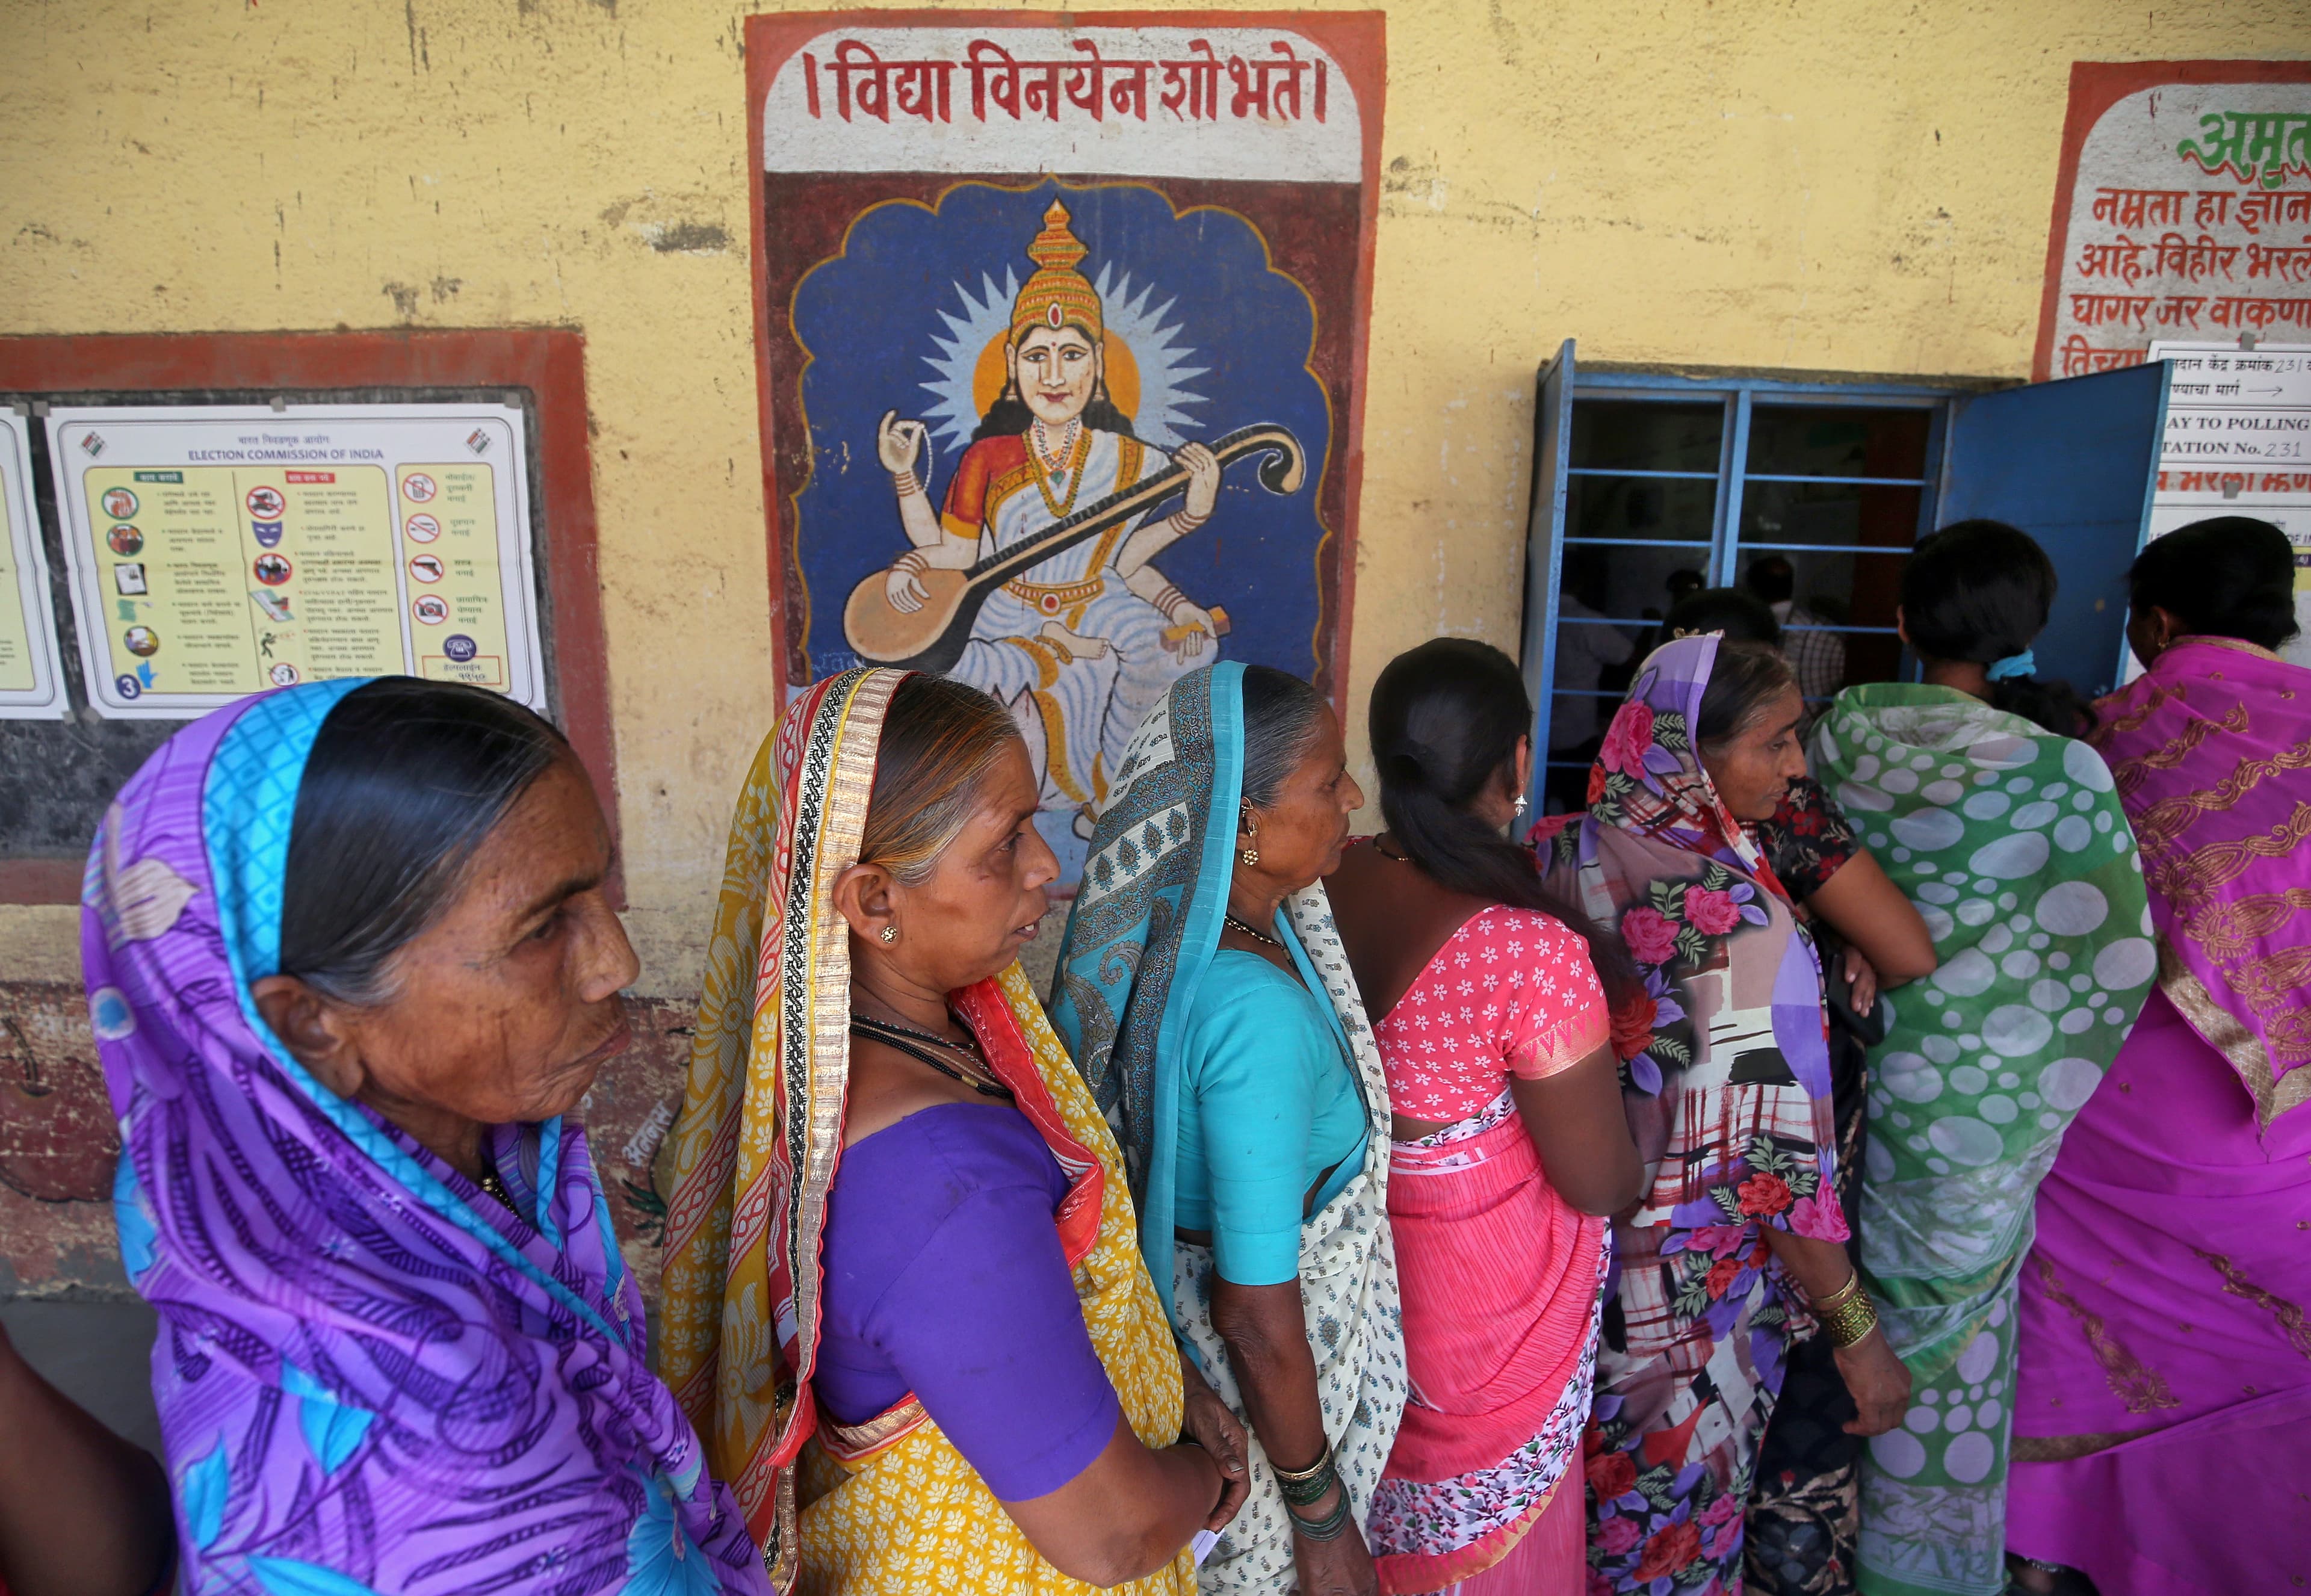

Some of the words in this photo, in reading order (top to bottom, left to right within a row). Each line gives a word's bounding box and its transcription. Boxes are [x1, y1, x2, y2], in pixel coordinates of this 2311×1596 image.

[961, 39, 1156, 122] विनयेन
[2093, 188, 2189, 229] नम्रता
[2194, 191, 2236, 230] हा
[2070, 294, 2155, 332] घागर
[2156, 297, 2208, 330] जर
[2167, 417, 2191, 429] AY
[2197, 418, 2221, 430] TO
[2227, 418, 2310, 431] POLLING
[188, 450, 244, 461] ELECTION
[247, 449, 327, 460] COMMISSION
[331, 449, 346, 459] OF
[349, 449, 384, 459] INDIA
[2162, 441, 2229, 453] TATION
[2234, 442, 2261, 455] No.
[2263, 442, 2301, 457] 231
[121, 677, 137, 696] 3
